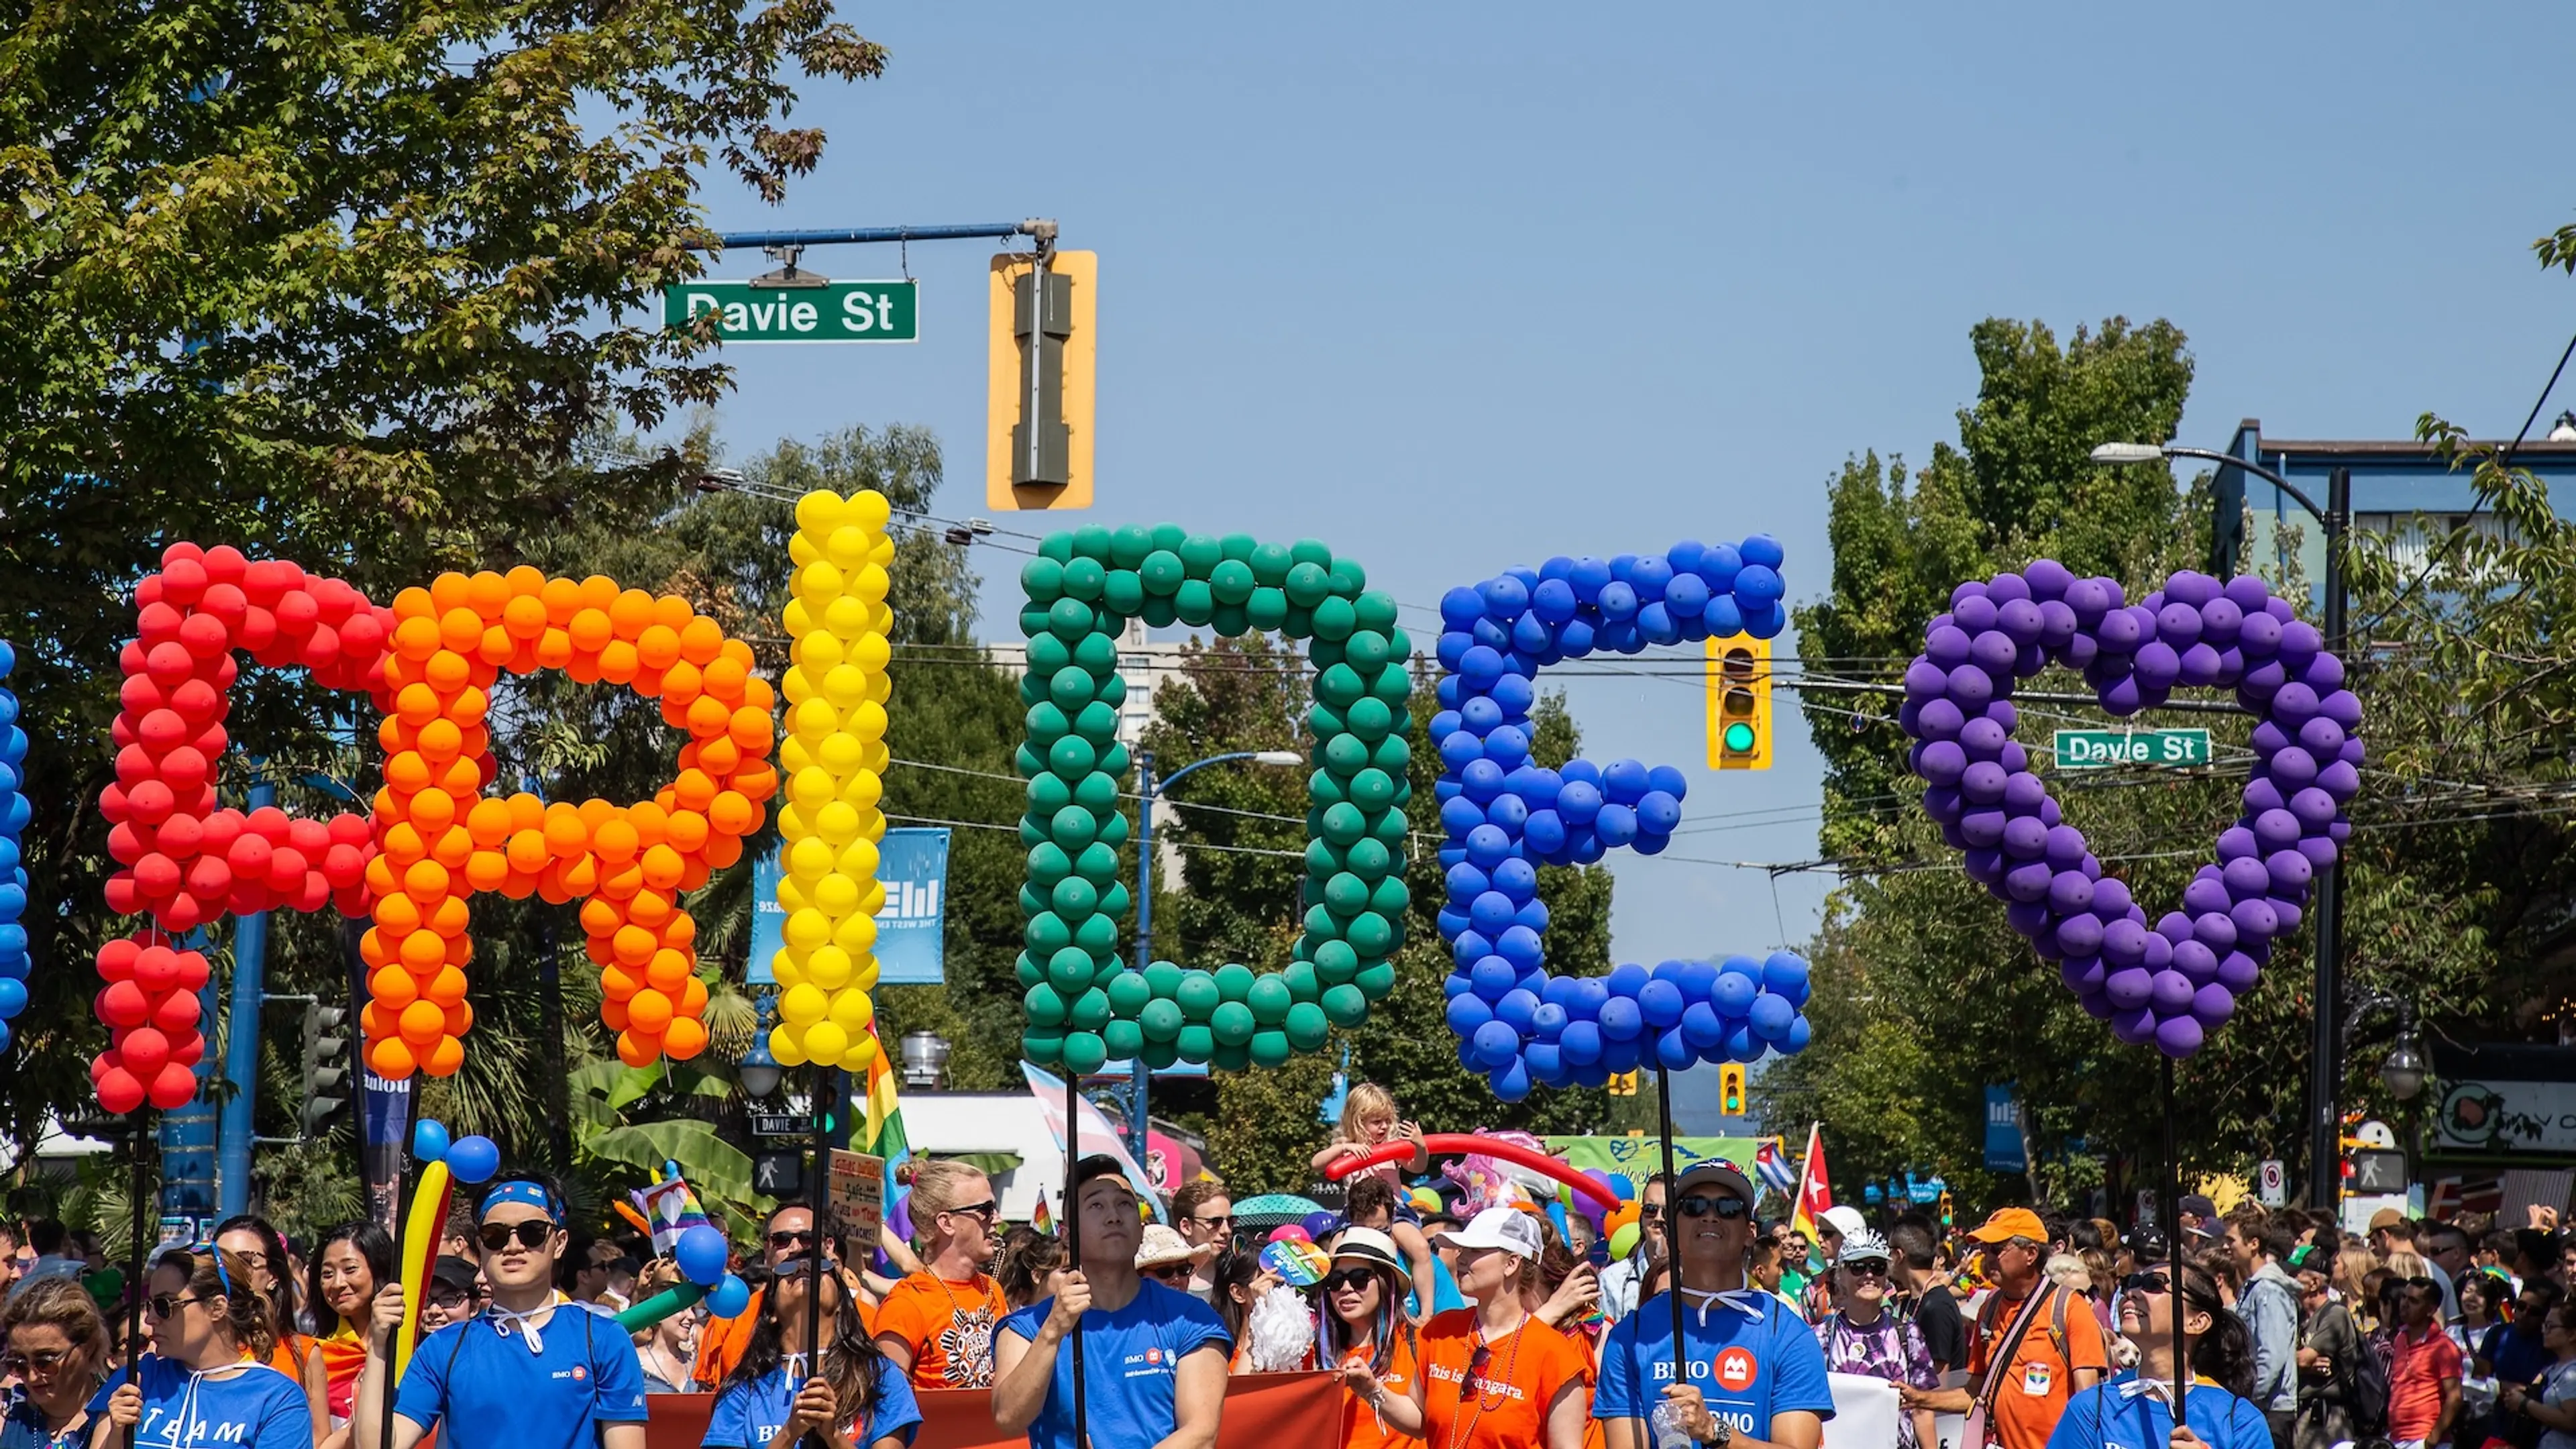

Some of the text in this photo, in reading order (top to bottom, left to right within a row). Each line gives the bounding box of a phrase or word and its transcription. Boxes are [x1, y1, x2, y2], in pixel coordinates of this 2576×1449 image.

[686, 291, 894, 332] Davie St
[2070, 736, 2195, 762] Davie St
[761, 1118, 791, 1132] DAVIE
[1270, 1248, 1303, 1279] Liberal
[551, 1371, 571, 1379] BMO
[1451, 1367, 1464, 1385] is
[1474, 1378, 1525, 1401] angara.
[142, 1407, 246, 1444] TEAM
